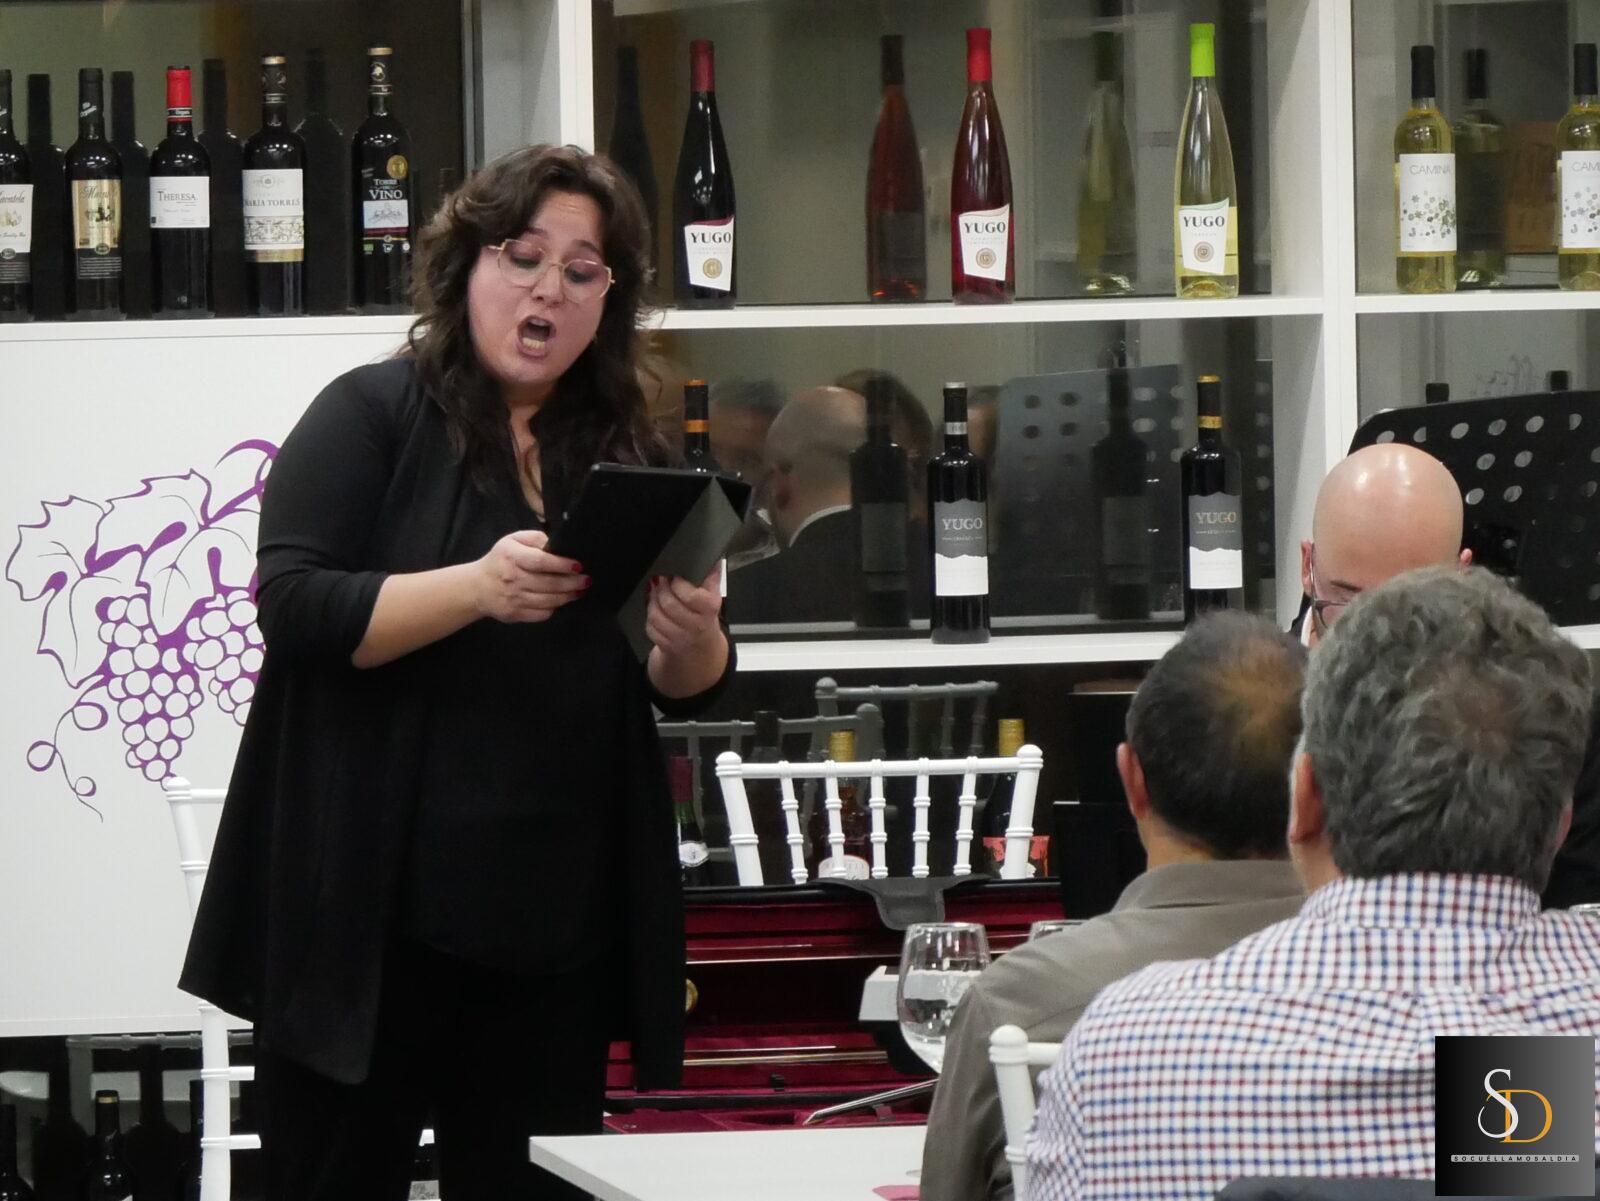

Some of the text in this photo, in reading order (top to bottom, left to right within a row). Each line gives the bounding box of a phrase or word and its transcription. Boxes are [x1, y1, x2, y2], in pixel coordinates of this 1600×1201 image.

[368, 189, 403, 200] VINO
[268, 199, 301, 207] TORRES
[1184, 216, 1225, 227] YUGO
[964, 222, 1006, 233] YUGO
[691, 232, 732, 243] YUGO
[1196, 511, 1237, 524] YUGO
[942, 517, 983, 530] YUGO
